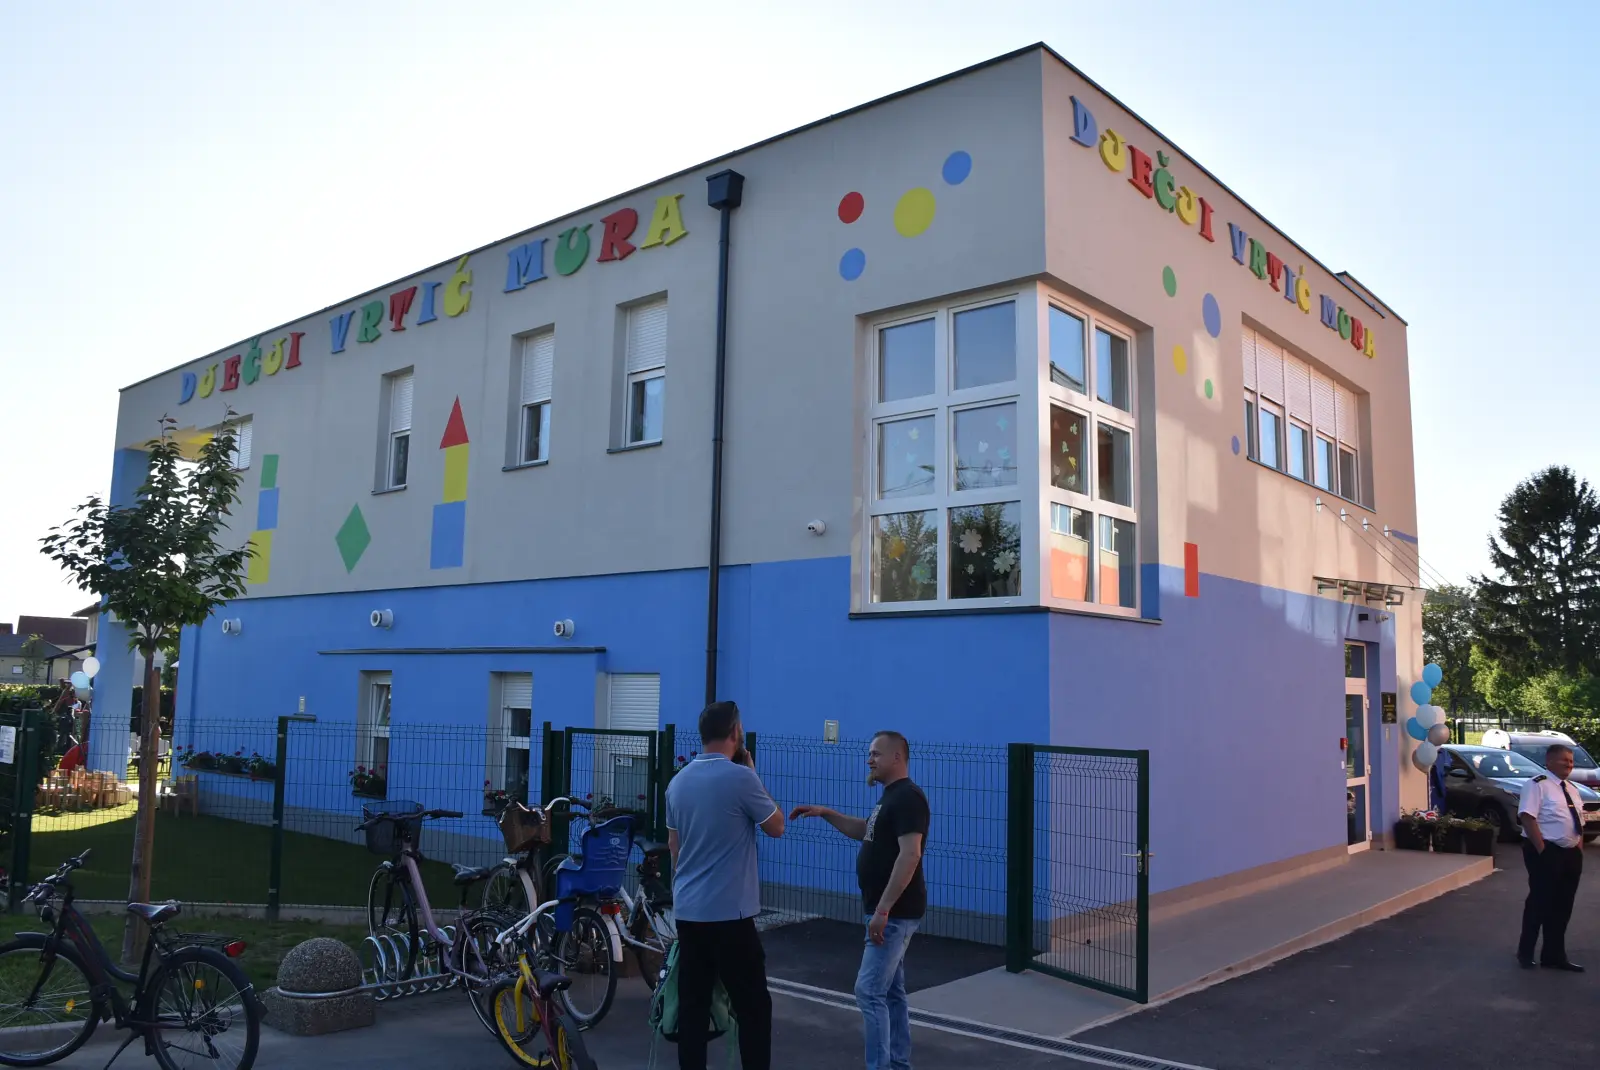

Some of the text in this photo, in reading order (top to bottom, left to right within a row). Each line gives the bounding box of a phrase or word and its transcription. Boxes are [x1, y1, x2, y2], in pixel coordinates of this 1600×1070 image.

[178, 193, 689, 405] DJEČJI VRTIĆ MURA
[1069, 95, 1375, 359] DJEČJI VRTIĆ MURA
